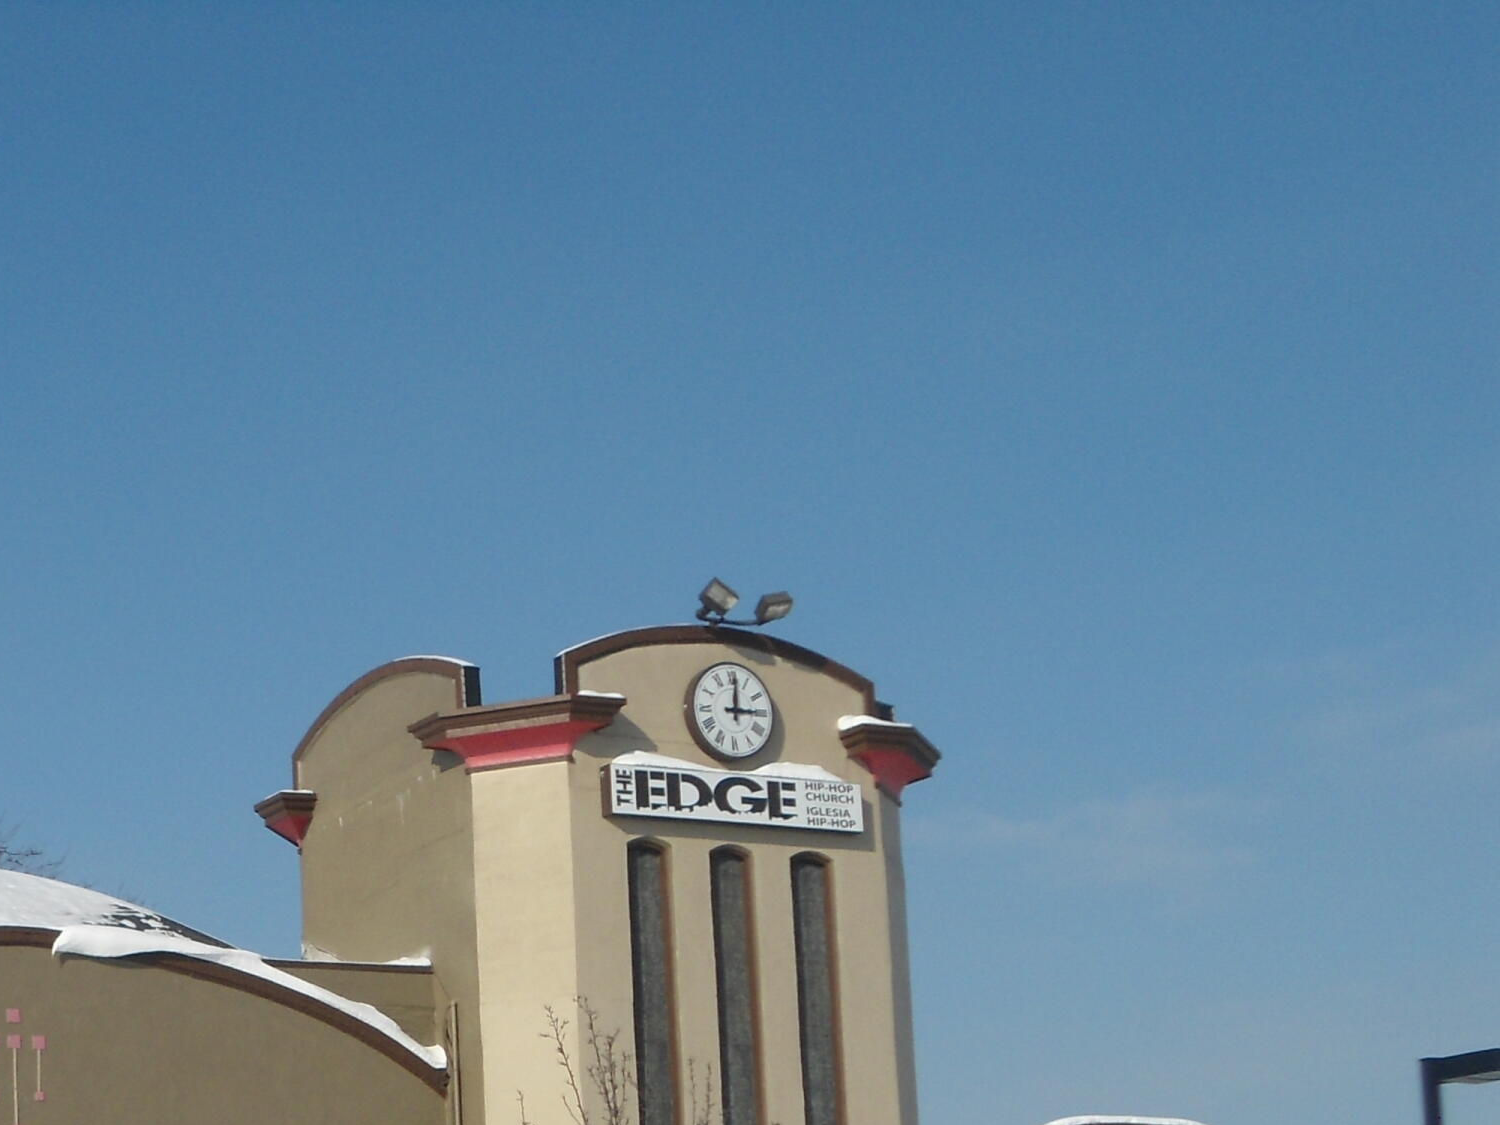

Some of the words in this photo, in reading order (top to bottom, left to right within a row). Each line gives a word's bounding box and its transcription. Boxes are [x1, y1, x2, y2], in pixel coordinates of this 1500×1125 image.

[804, 781, 854, 794] HIP-HOP
[615, 769, 633, 806] THE
[634, 769, 798, 821] EDGE
[805, 791, 854, 805] CHURCH
[806, 806, 851, 818] IGLESIA
[807, 816, 856, 829] HIP-HOP
